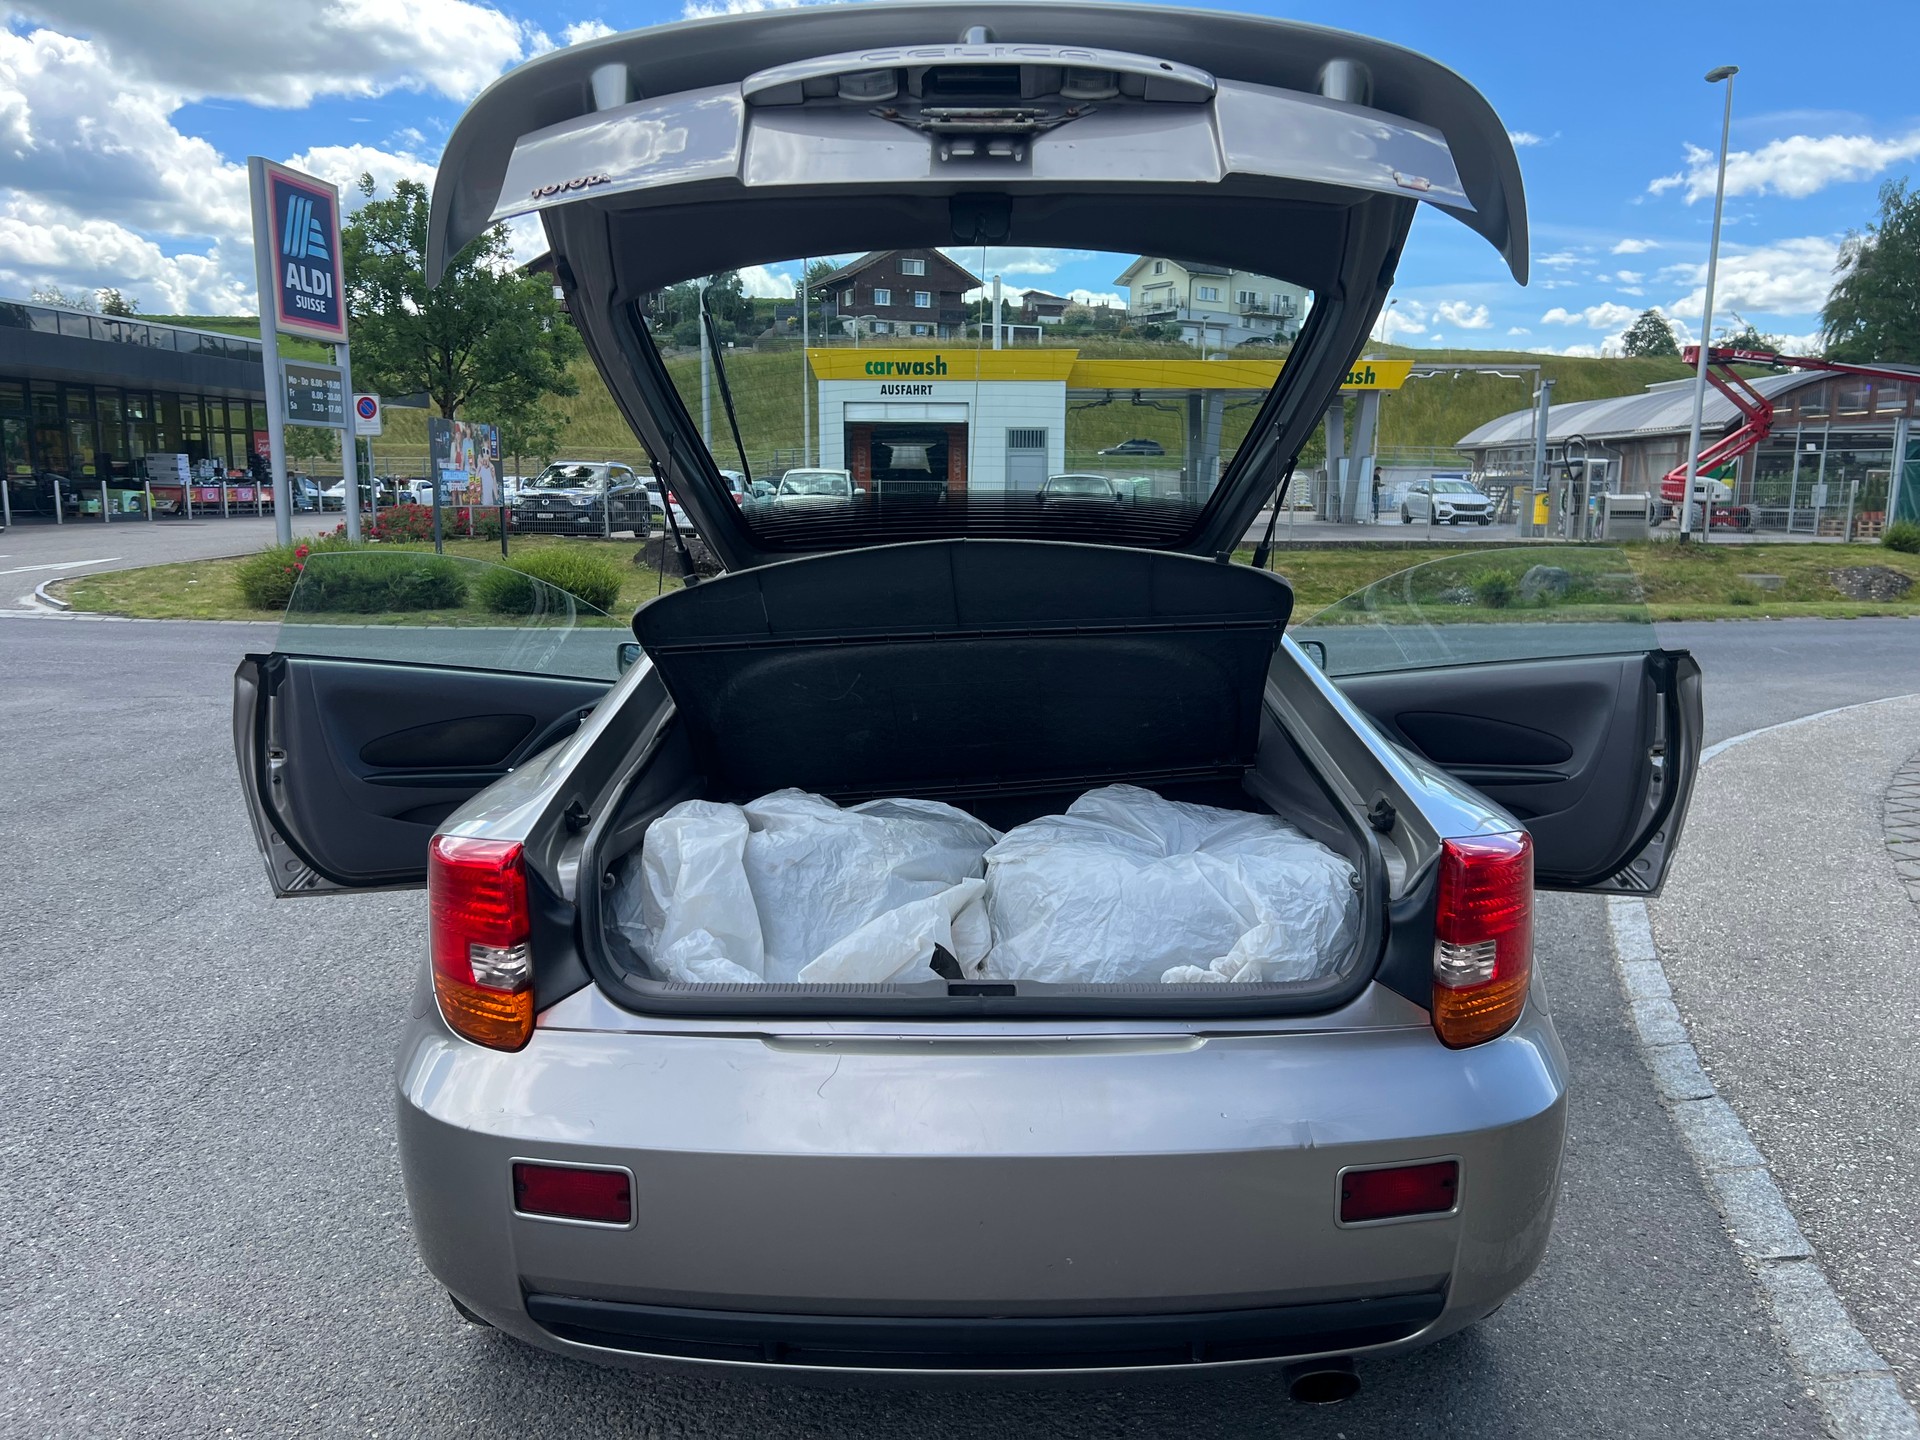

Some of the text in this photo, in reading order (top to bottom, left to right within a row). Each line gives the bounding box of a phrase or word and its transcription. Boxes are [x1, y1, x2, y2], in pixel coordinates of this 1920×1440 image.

[859, 47, 1098, 62] CELICA
[531, 173, 612, 200] TOYOTA
[286, 262, 333, 299] ALDI
[295, 294, 327, 313] SUISSE
[865, 354, 948, 376] carwash
[288, 375, 298, 385] Mo
[300, 376, 309, 386] Do
[289, 388, 296, 397] Fr
[880, 384, 934, 396] AUSFAHRT
[290, 400, 298, 410] Sa
